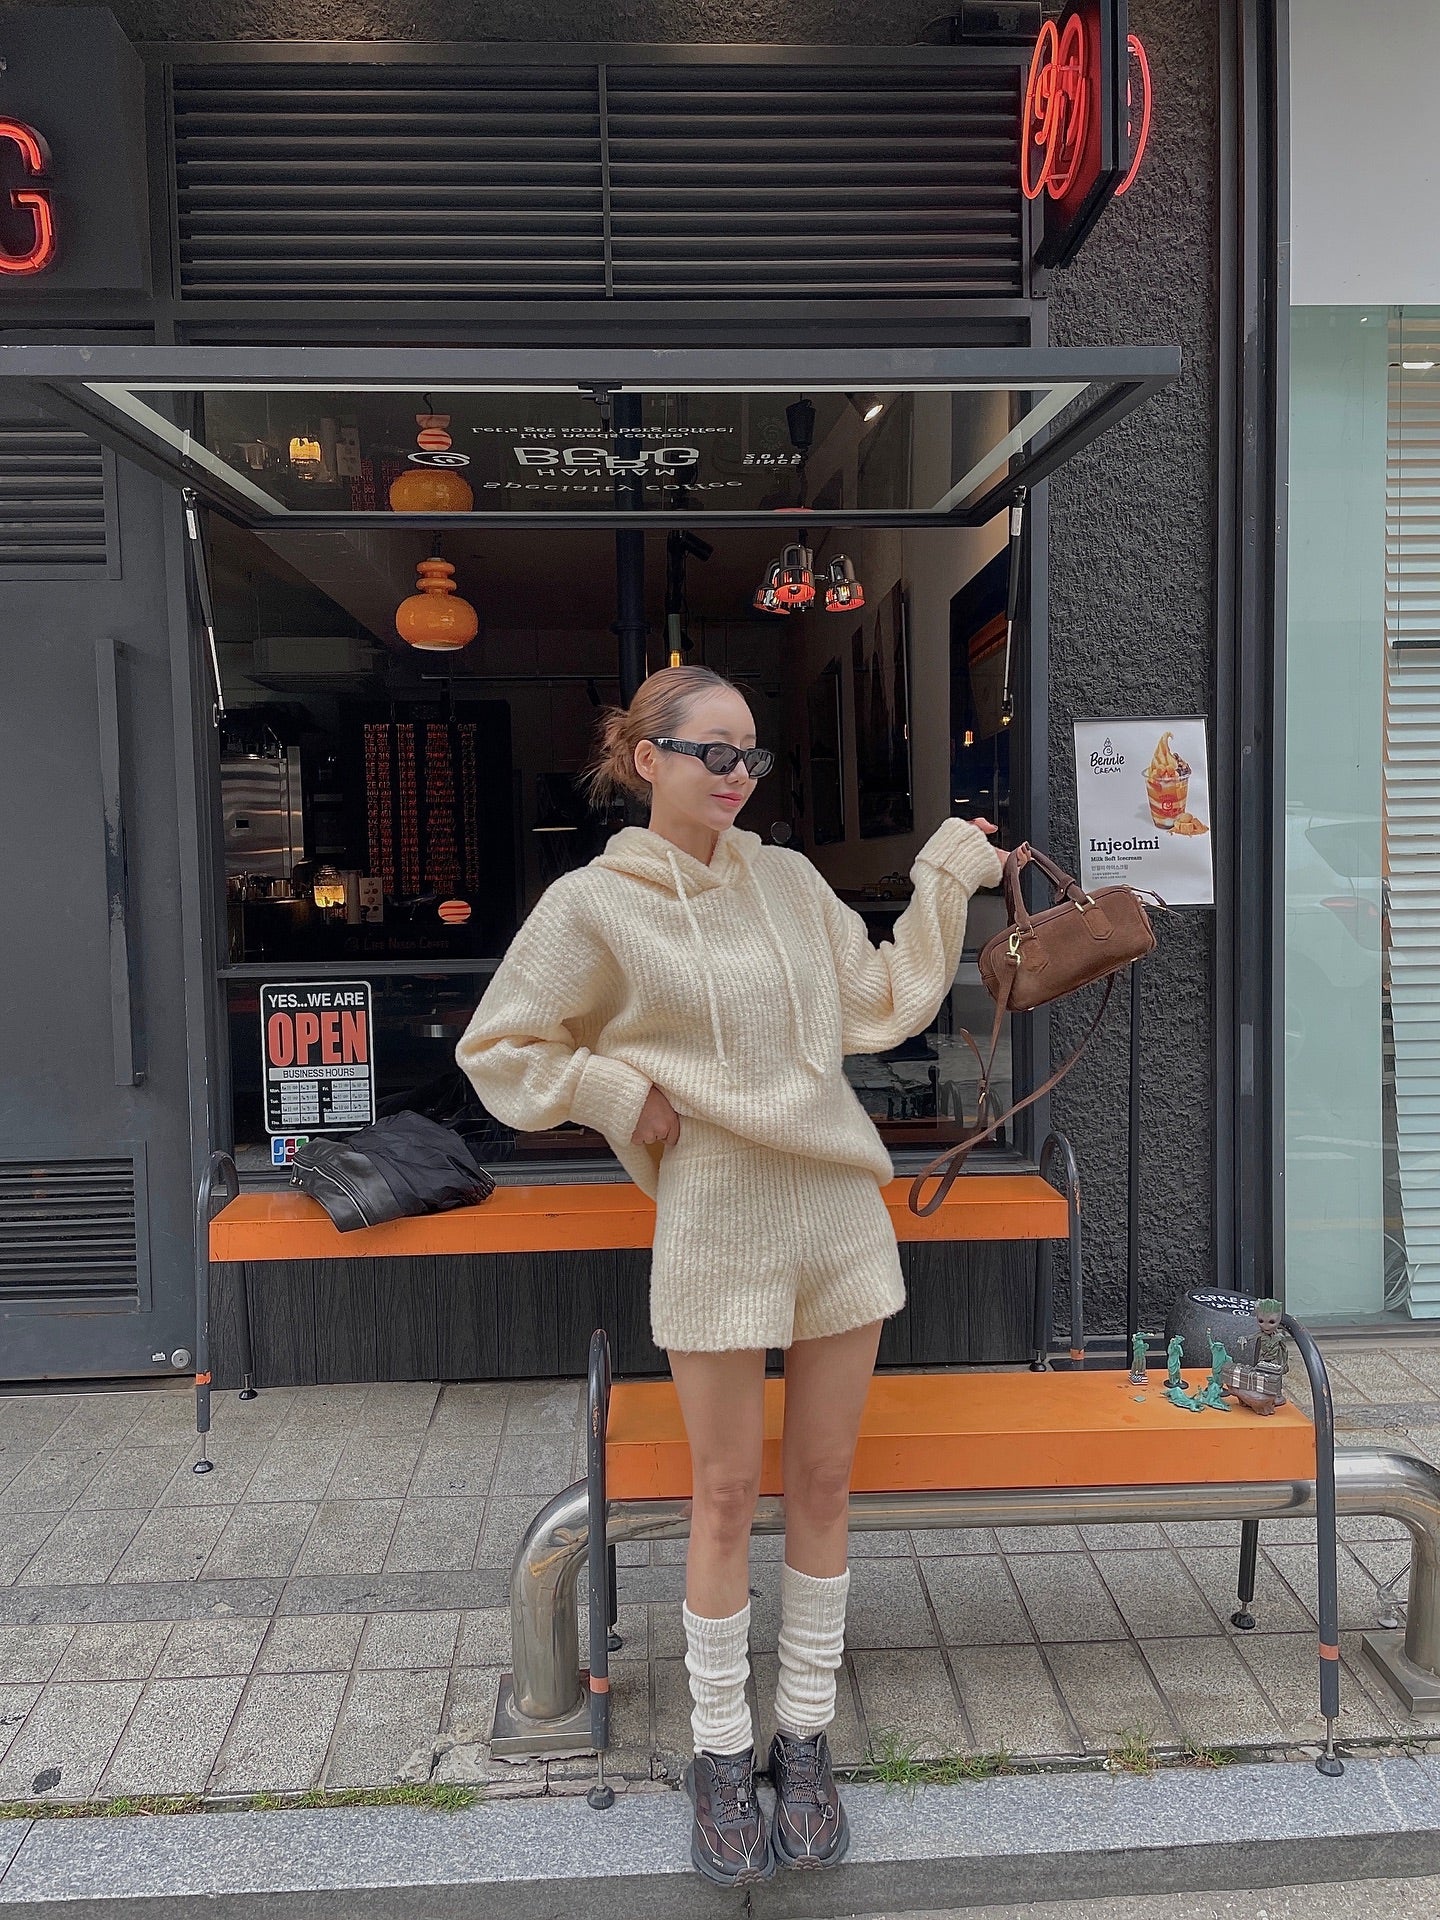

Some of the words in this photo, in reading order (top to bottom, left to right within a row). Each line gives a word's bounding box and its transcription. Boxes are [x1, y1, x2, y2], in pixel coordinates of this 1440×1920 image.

[364, 724, 390, 732] FLIGHT
[1090, 752, 1125, 767] Bennie
[1094, 766, 1121, 775] CREAM
[1090, 836, 1160, 855] Injeolmi
[333, 992, 365, 1006] ARE
[268, 1010, 368, 1067] OPEN
[283, 1069, 324, 1079] BUSINESS
[325, 1067, 355, 1077] HOURS
